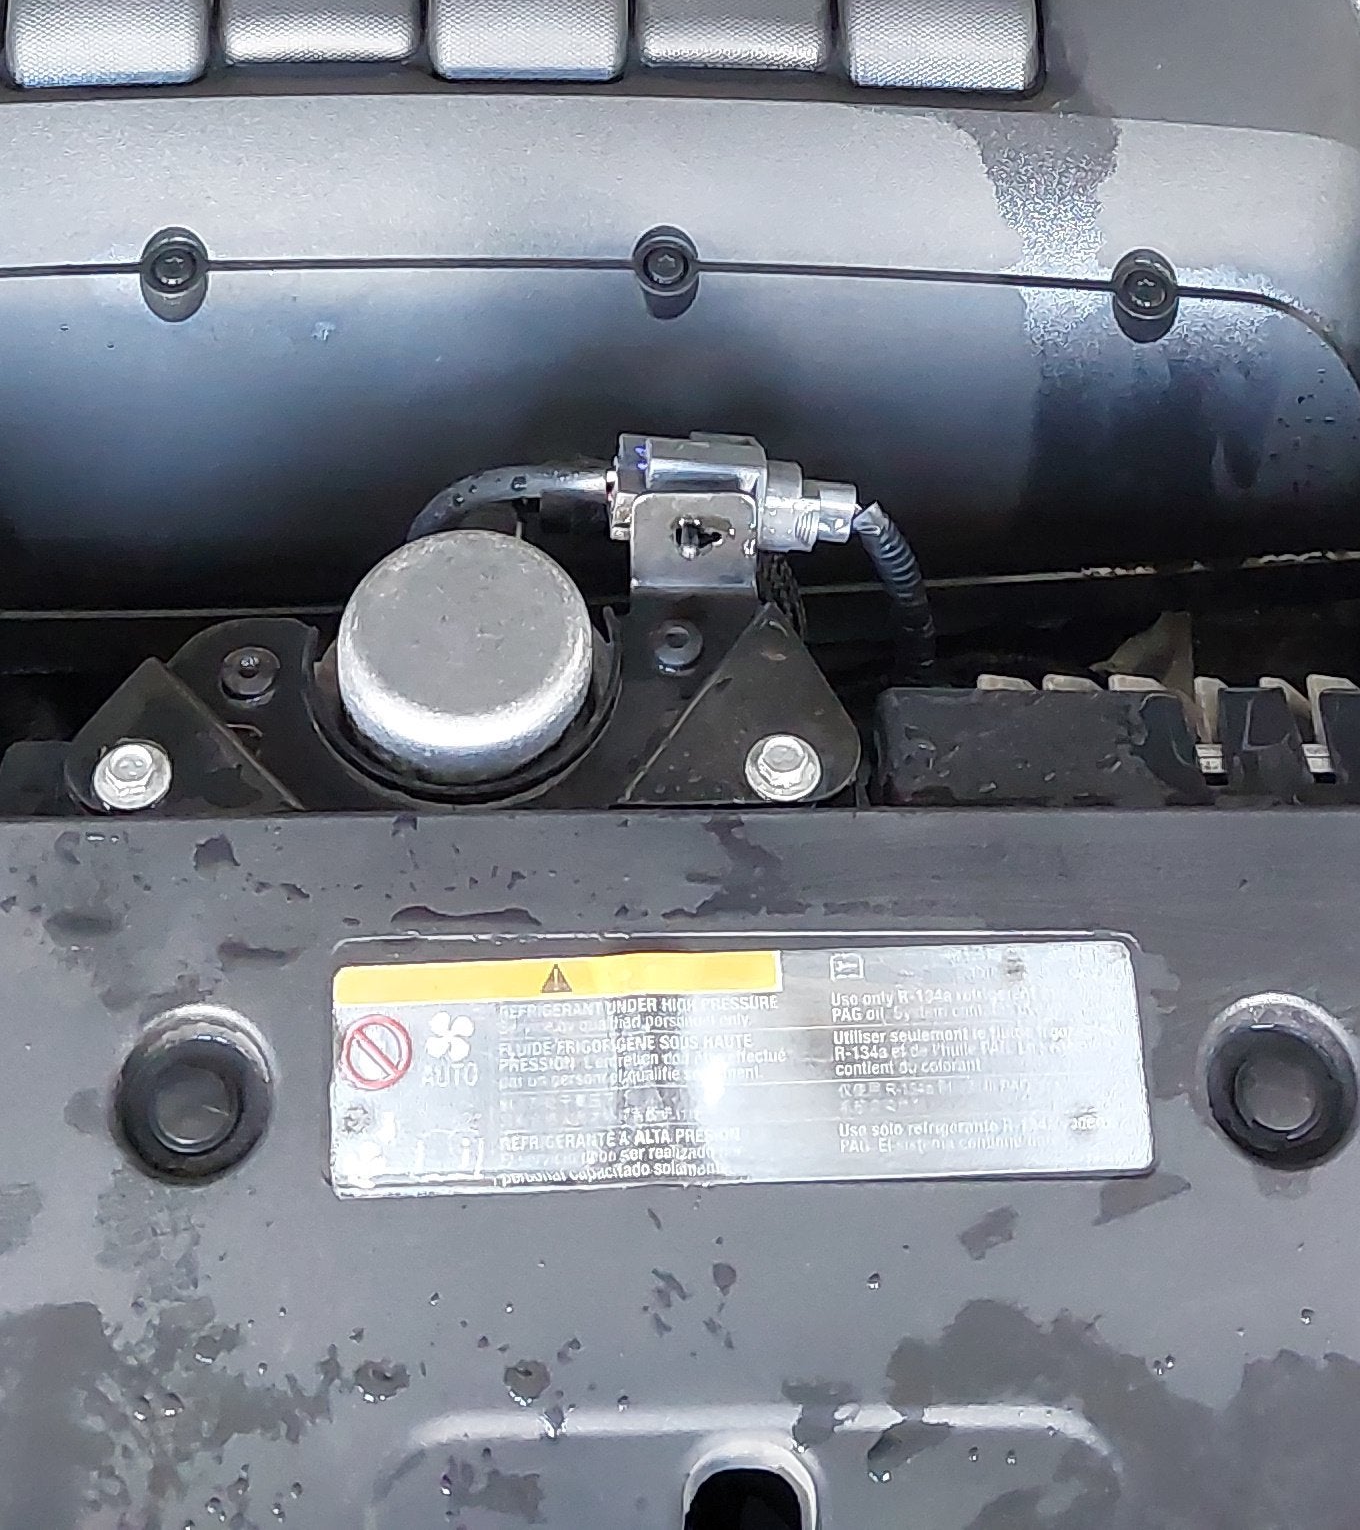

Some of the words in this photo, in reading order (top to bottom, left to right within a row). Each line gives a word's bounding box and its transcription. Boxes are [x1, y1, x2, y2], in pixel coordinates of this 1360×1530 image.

[606, 997, 658, 1015] UNDER
[661, 995, 695, 1013] HIGH
[702, 994, 779, 1012] PRESSURE
[830, 991, 859, 1007] Use
[862, 989, 894, 1009] only
[896, 988, 953, 1006] R-134a
[831, 1007, 863, 1023] PAG
[498, 1040, 554, 1059] FLUIDE
[658, 1033, 699, 1051] SOUS
[702, 1032, 753, 1049] HAUTE
[832, 1028, 887, 1046] Utiliser
[889, 1025, 969, 1045] seulement
[834, 1045, 888, 1062] R-134a
[890, 1043, 907, 1060] et
[421, 1060, 480, 1088] AUTO
[834, 1060, 895, 1077] contient
[633, 1127, 674, 1147] ALTA
[619, 1146, 646, 1163] ser
